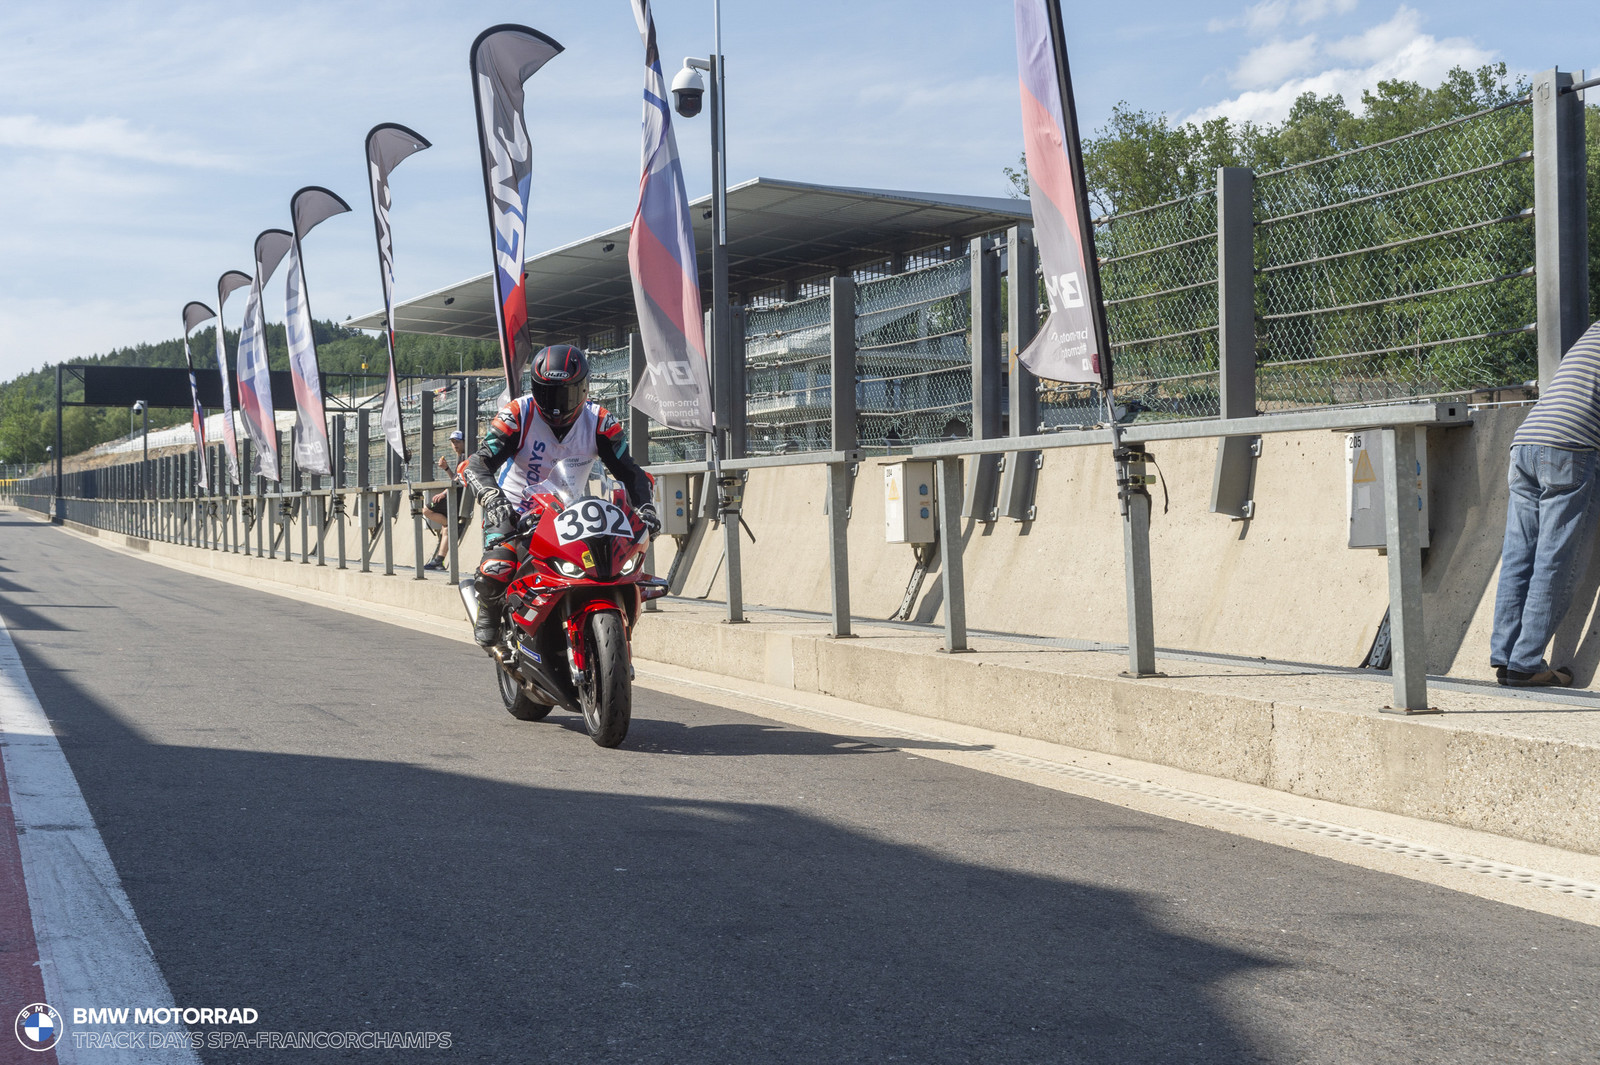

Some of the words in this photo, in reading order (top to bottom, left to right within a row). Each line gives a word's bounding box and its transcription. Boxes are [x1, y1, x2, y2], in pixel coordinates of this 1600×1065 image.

[527, 440, 546, 482] DAYS
[1349, 436, 1362, 448] 205
[558, 501, 631, 541] 392
